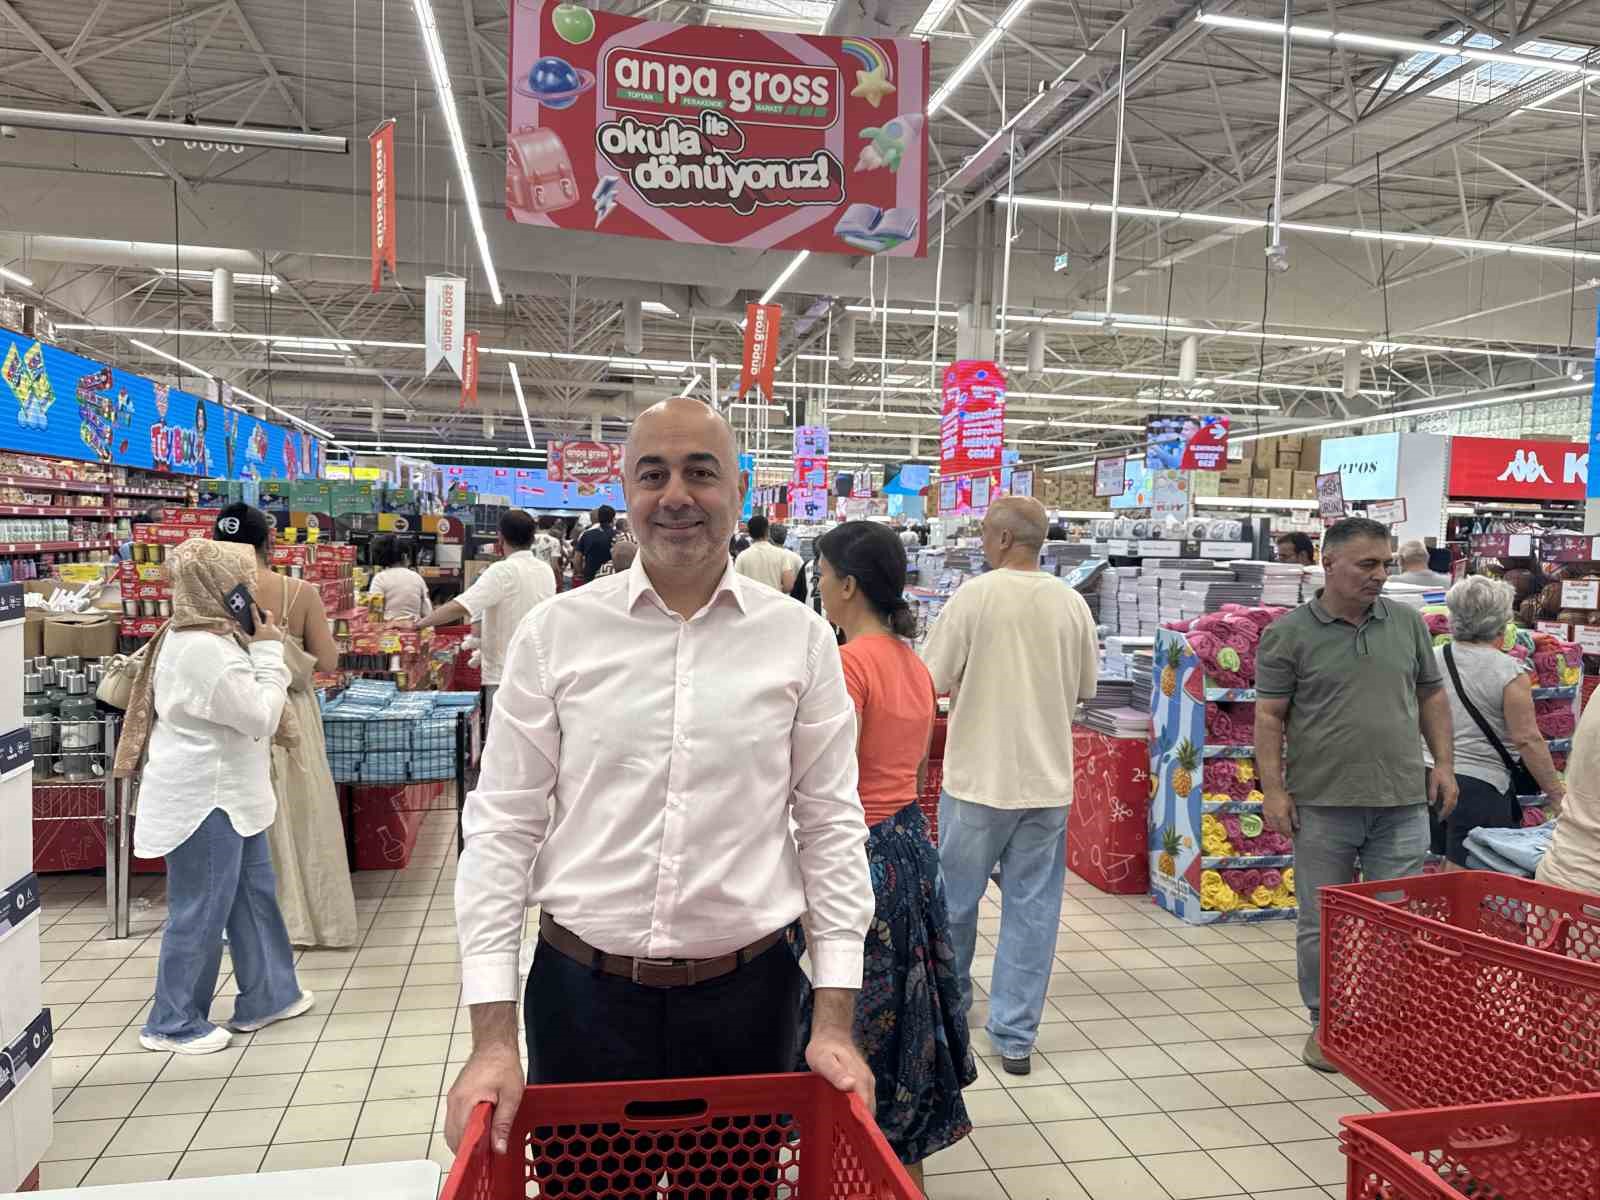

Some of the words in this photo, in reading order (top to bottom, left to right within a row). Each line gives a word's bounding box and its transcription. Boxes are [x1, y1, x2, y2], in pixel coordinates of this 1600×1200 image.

[615, 57, 717, 104] anpa
[728, 69, 829, 113] gross
[628, 91, 655, 100] TOPTAN
[683, 97, 723, 108] PERAKENDE
[754, 104, 783, 114] MARKET
[602, 122, 702, 154] okula
[705, 114, 729, 136] ile
[376, 138, 384, 193] gross
[635, 154, 829, 198] dönüyoruz!
[376, 195, 384, 248] anpa
[754, 309, 765, 342] gross
[751, 343, 762, 375] anpa
